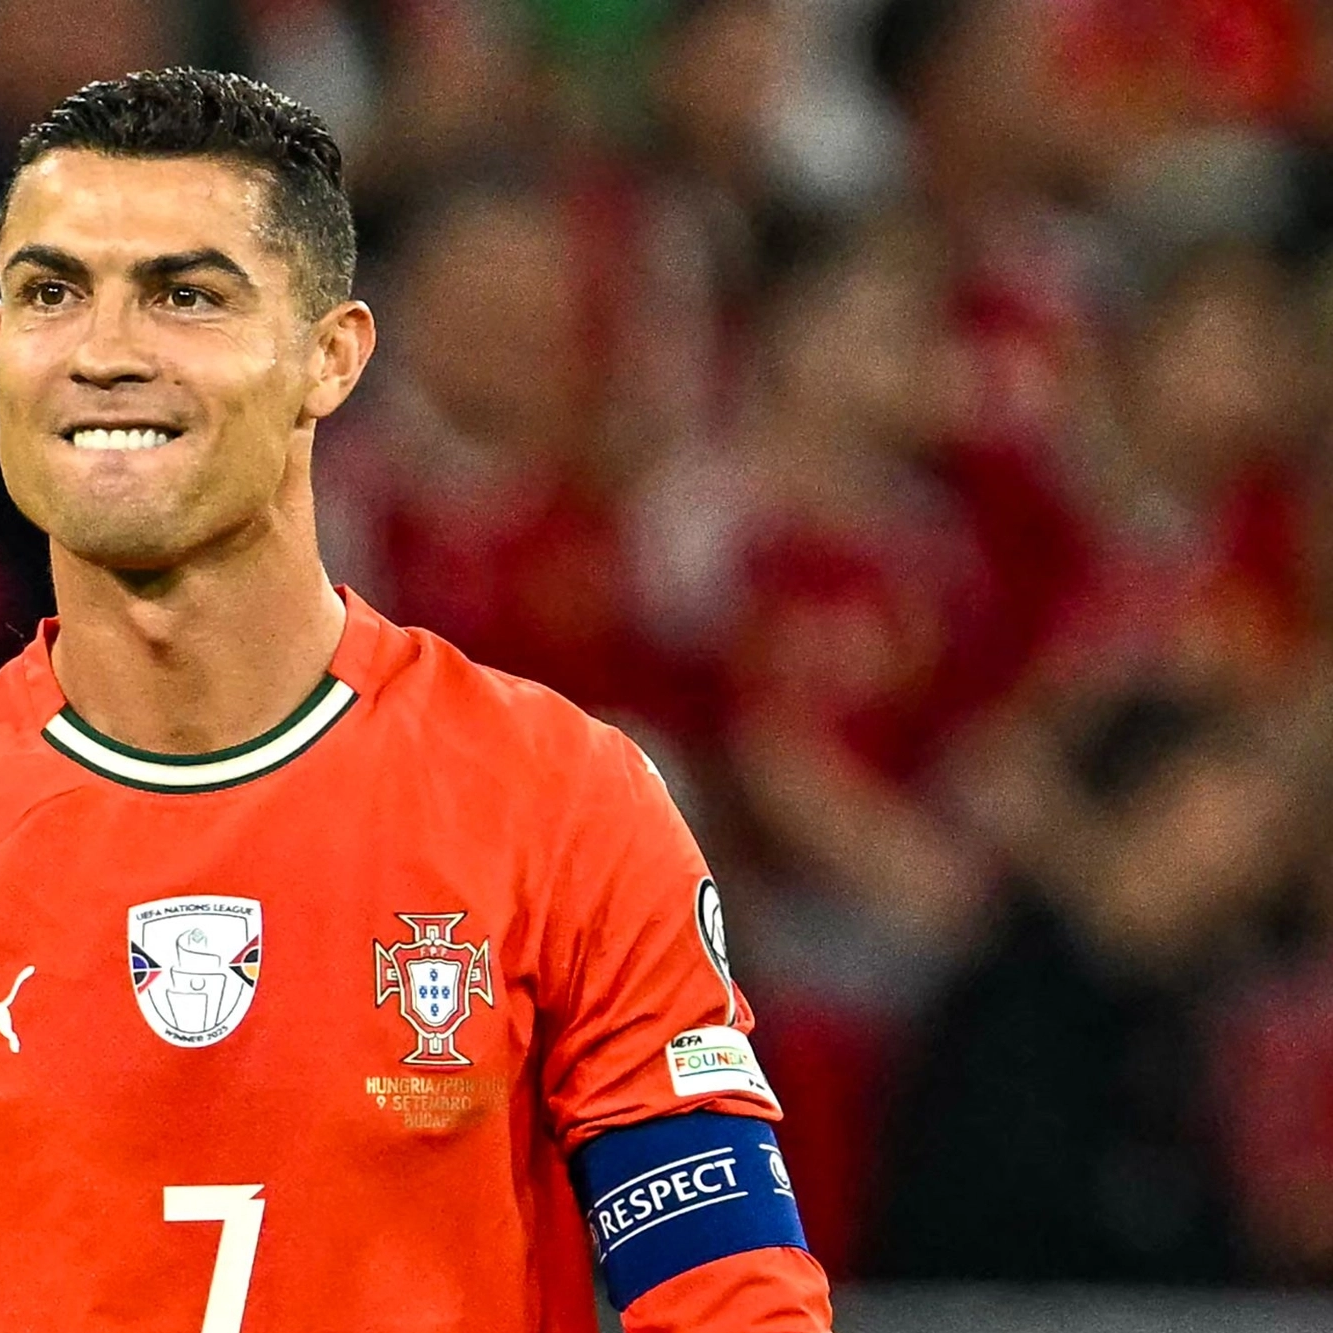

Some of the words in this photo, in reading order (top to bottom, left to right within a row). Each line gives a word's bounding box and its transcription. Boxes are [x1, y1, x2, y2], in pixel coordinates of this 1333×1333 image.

[136, 908, 162, 921] UEFA
[164, 903, 211, 914] NATIONS
[213, 904, 254, 916] LEAGUE
[165, 1027, 204, 1043] WINNER
[671, 1035, 703, 1049] UEFA
[376, 1095, 386, 1111] 9
[599, 1158, 738, 1239] RESPECT
